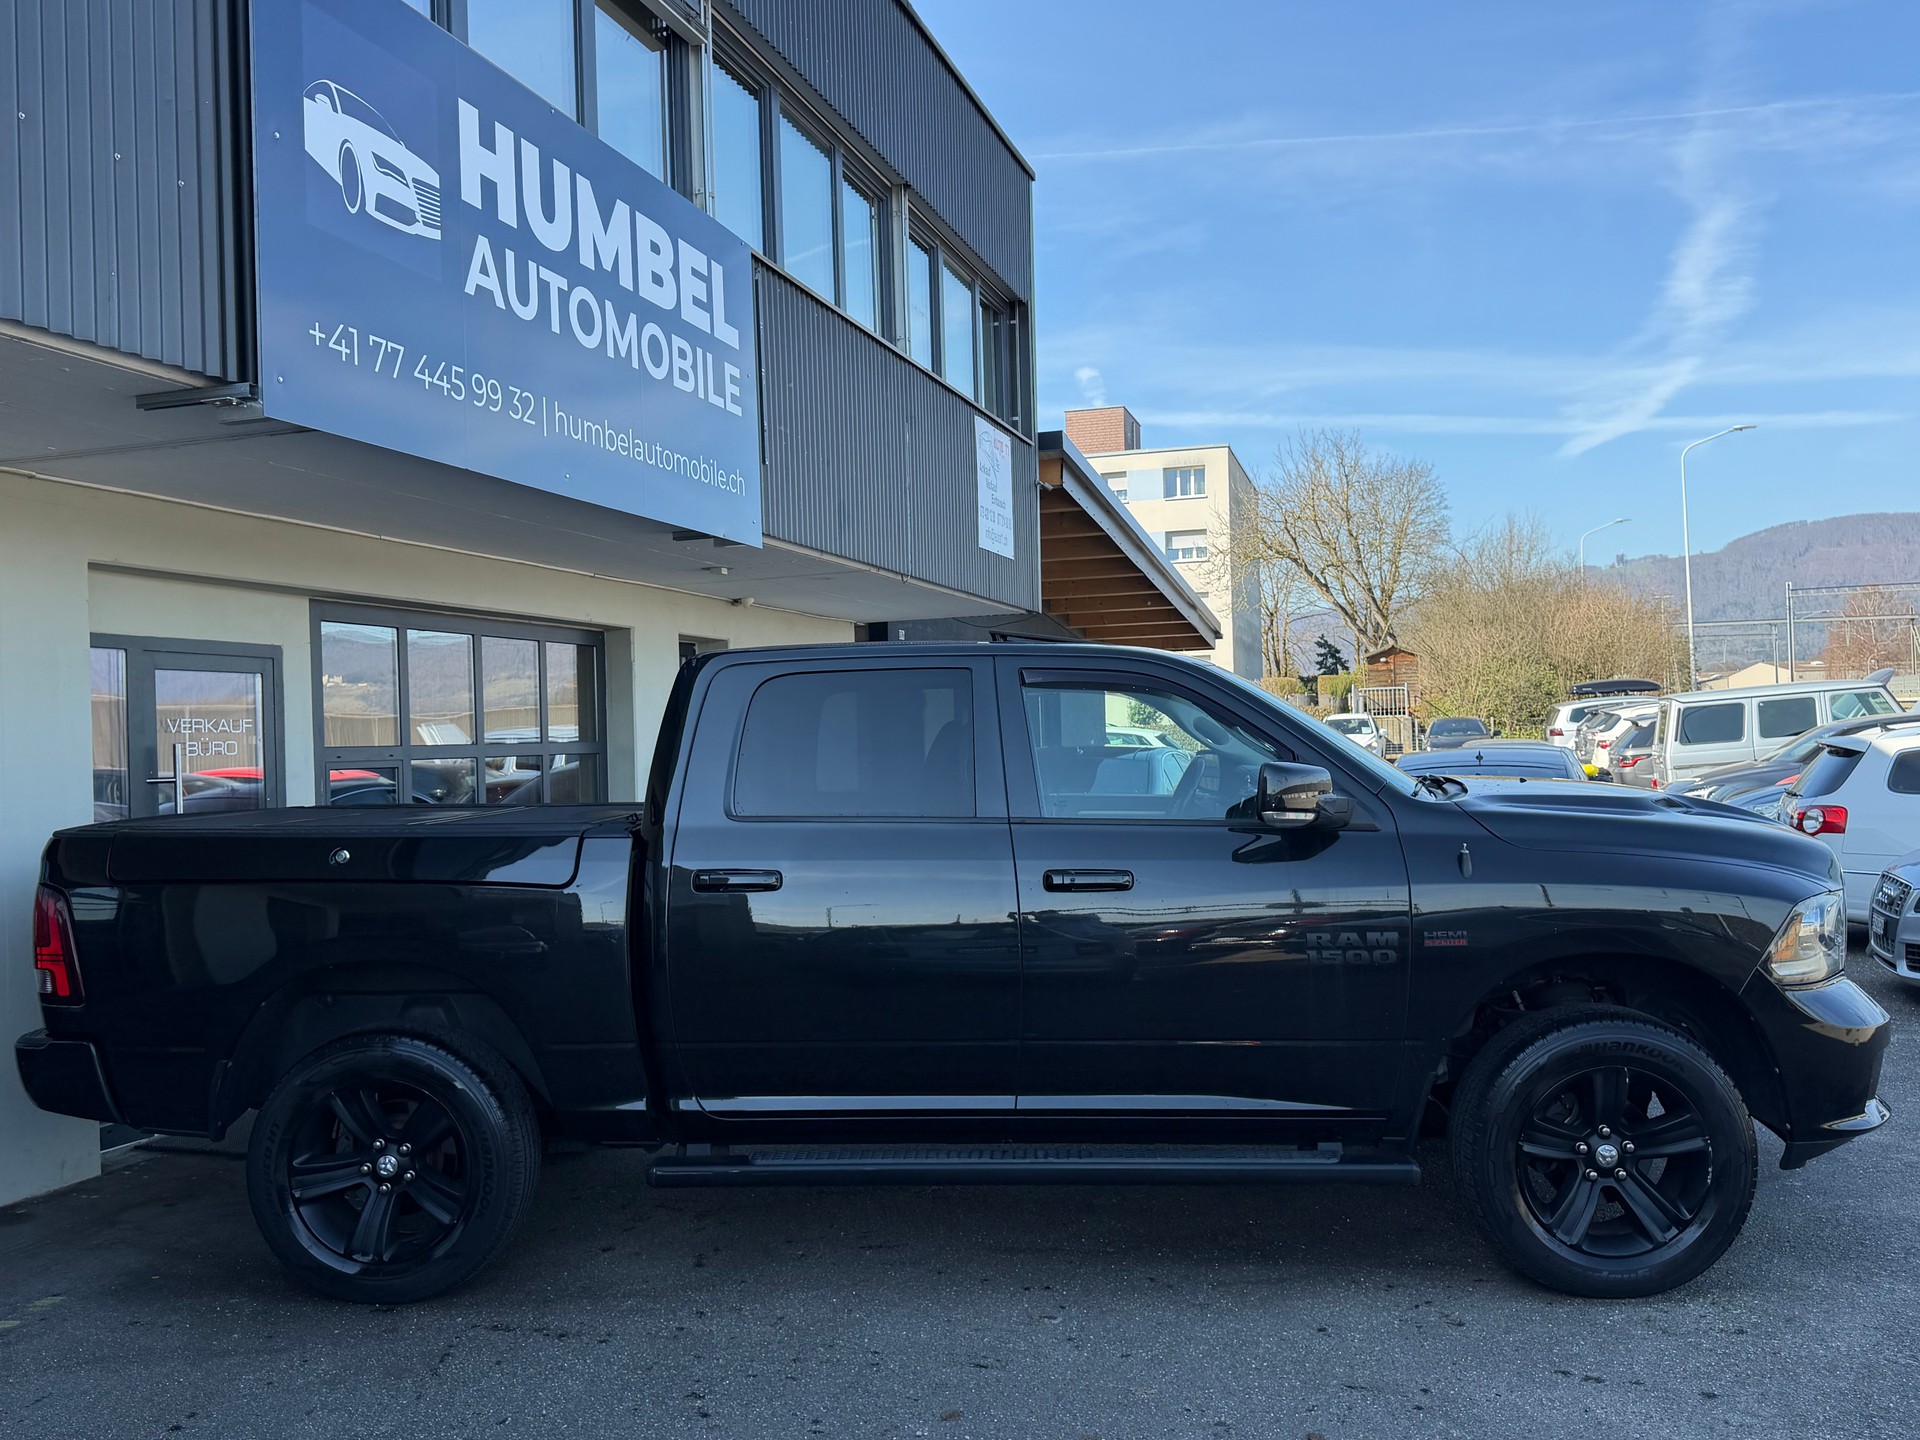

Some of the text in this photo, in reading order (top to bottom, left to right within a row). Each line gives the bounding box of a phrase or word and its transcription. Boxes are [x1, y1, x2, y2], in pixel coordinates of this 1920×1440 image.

[458, 97, 740, 350] HUMBEL
[464, 234, 743, 417] AUTOMOBILE
[309, 322, 359, 366] +41
[369, 335, 405, 379] 77
[413, 355, 466, 401] 445
[471, 373, 502, 413] 99
[508, 386, 536, 426] 32
[555, 401, 747, 497] humbelautomobile.ch
[167, 719, 252, 733] VERKAUF
[187, 737, 238, 756] BÜRO
[1306, 931, 1399, 948] RAM
[1423, 930, 1468, 939] HEMI
[1306, 949, 1398, 965] 1500
